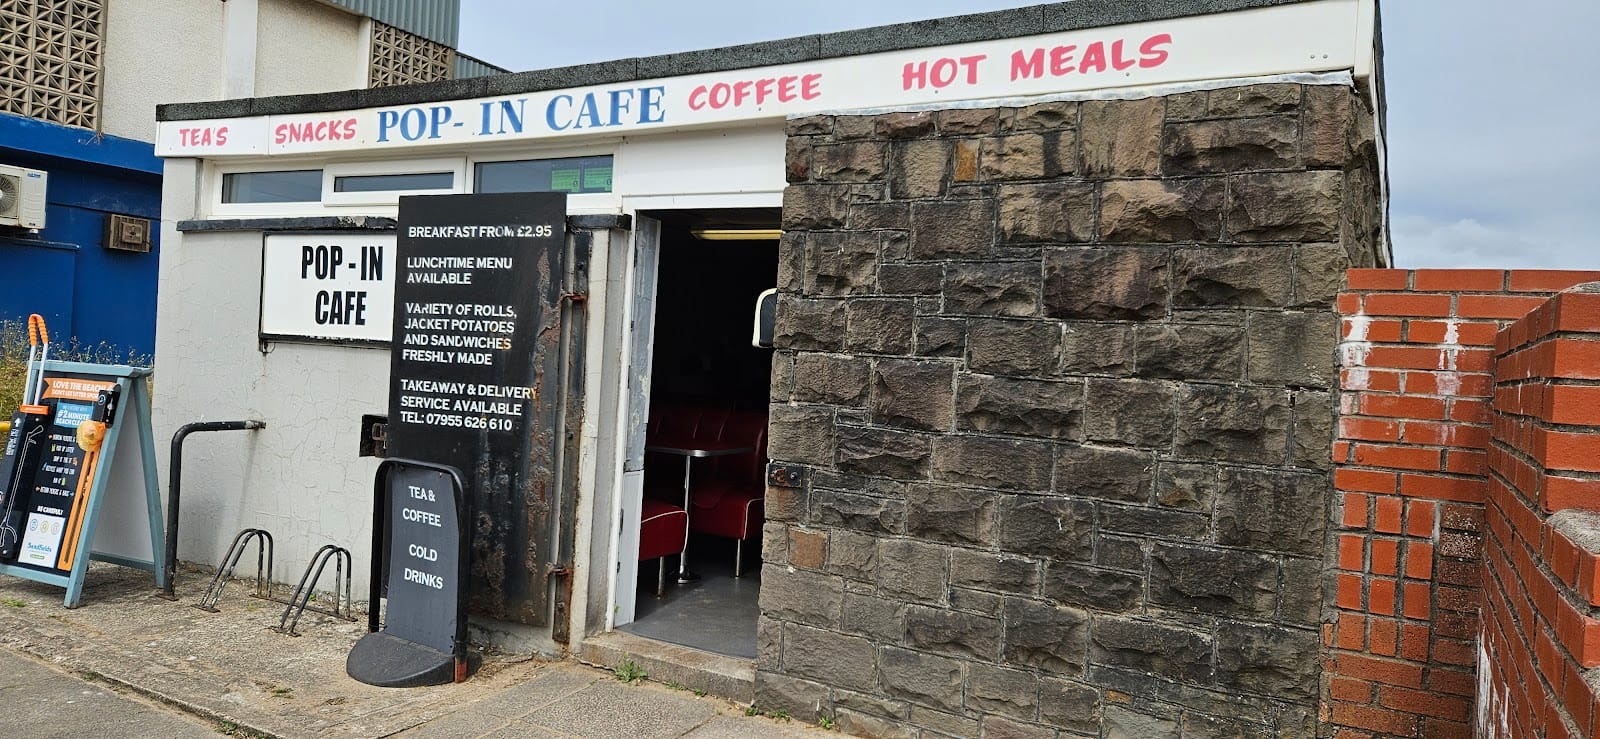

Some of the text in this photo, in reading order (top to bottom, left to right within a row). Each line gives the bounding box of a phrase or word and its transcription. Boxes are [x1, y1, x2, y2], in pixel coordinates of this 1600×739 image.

[901, 33, 1173, 91] HOT MEALS
[688, 73, 823, 111] COFFEE
[479, 99, 528, 136] IN
[545, 86, 665, 131] CAFE
[180, 127, 228, 147] TEA'S
[275, 119, 357, 144] SNACKS
[408, 225, 552, 238] BREAKFAST FROM £2.95
[407, 257, 512, 269] LUNCHTIME MENU
[407, 273, 472, 285] AVAILABLE
[315, 290, 367, 325] CAFE
[406, 303, 517, 319] VARIETY OF ROLLS,
[404, 318, 515, 333] JACKET POTATOES
[403, 334, 512, 350] AND SANDWICHES
[402, 349, 493, 366] FRESHLY MADE
[401, 379, 538, 400] TAKEAWAY & DELIVERY
[401, 395, 522, 416] SERVICE AVAILABLE
[400, 411, 513, 431] TEL: 07955 626 610
[408, 486, 436, 502] TEA &
[402, 507, 442, 528] COFFEE
[409, 543, 438, 562] COLD
[404, 568, 444, 590] DRINKS
